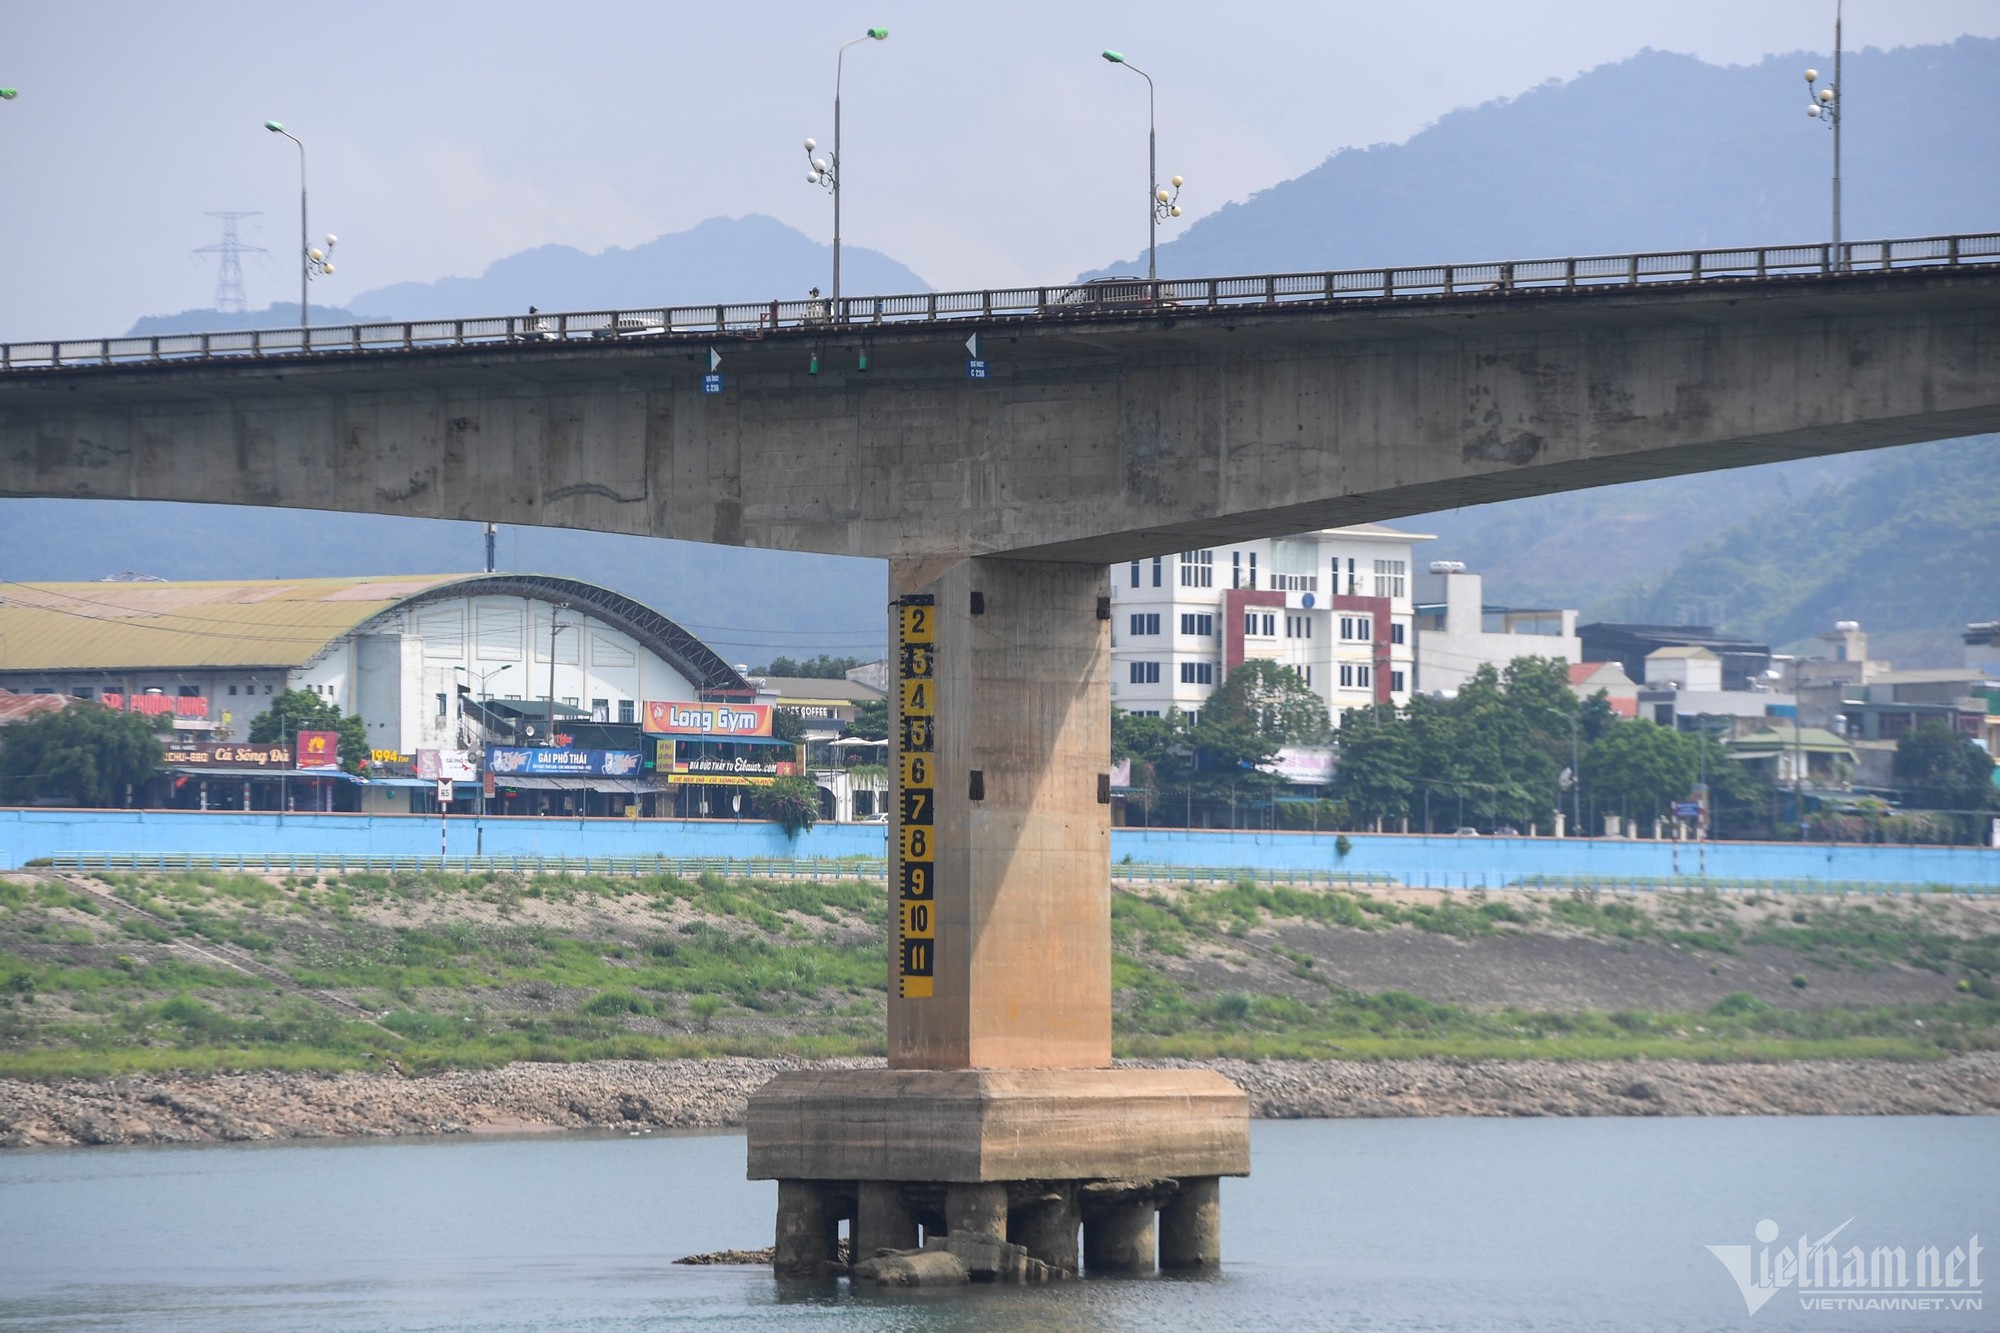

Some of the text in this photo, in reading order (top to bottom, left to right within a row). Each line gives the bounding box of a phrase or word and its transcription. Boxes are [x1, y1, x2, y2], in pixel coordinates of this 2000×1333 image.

[912, 609, 925, 633] 2
[912, 647, 926, 675] 3
[910, 683, 925, 710] 4
[669, 706, 757, 734] Long Gym
[800, 706, 828, 718] COFFEE
[911, 718, 925, 746] 5
[215, 748, 232, 761] Cá
[235, 748, 268, 765] Sông
[370, 749, 397, 763] 1994
[911, 757, 925, 784] 6
[912, 795, 925, 820] 7
[911, 829, 926, 858] 8
[911, 868, 925, 895] 9
[910, 905, 928, 932] 10
[912, 944, 925, 970] 11
